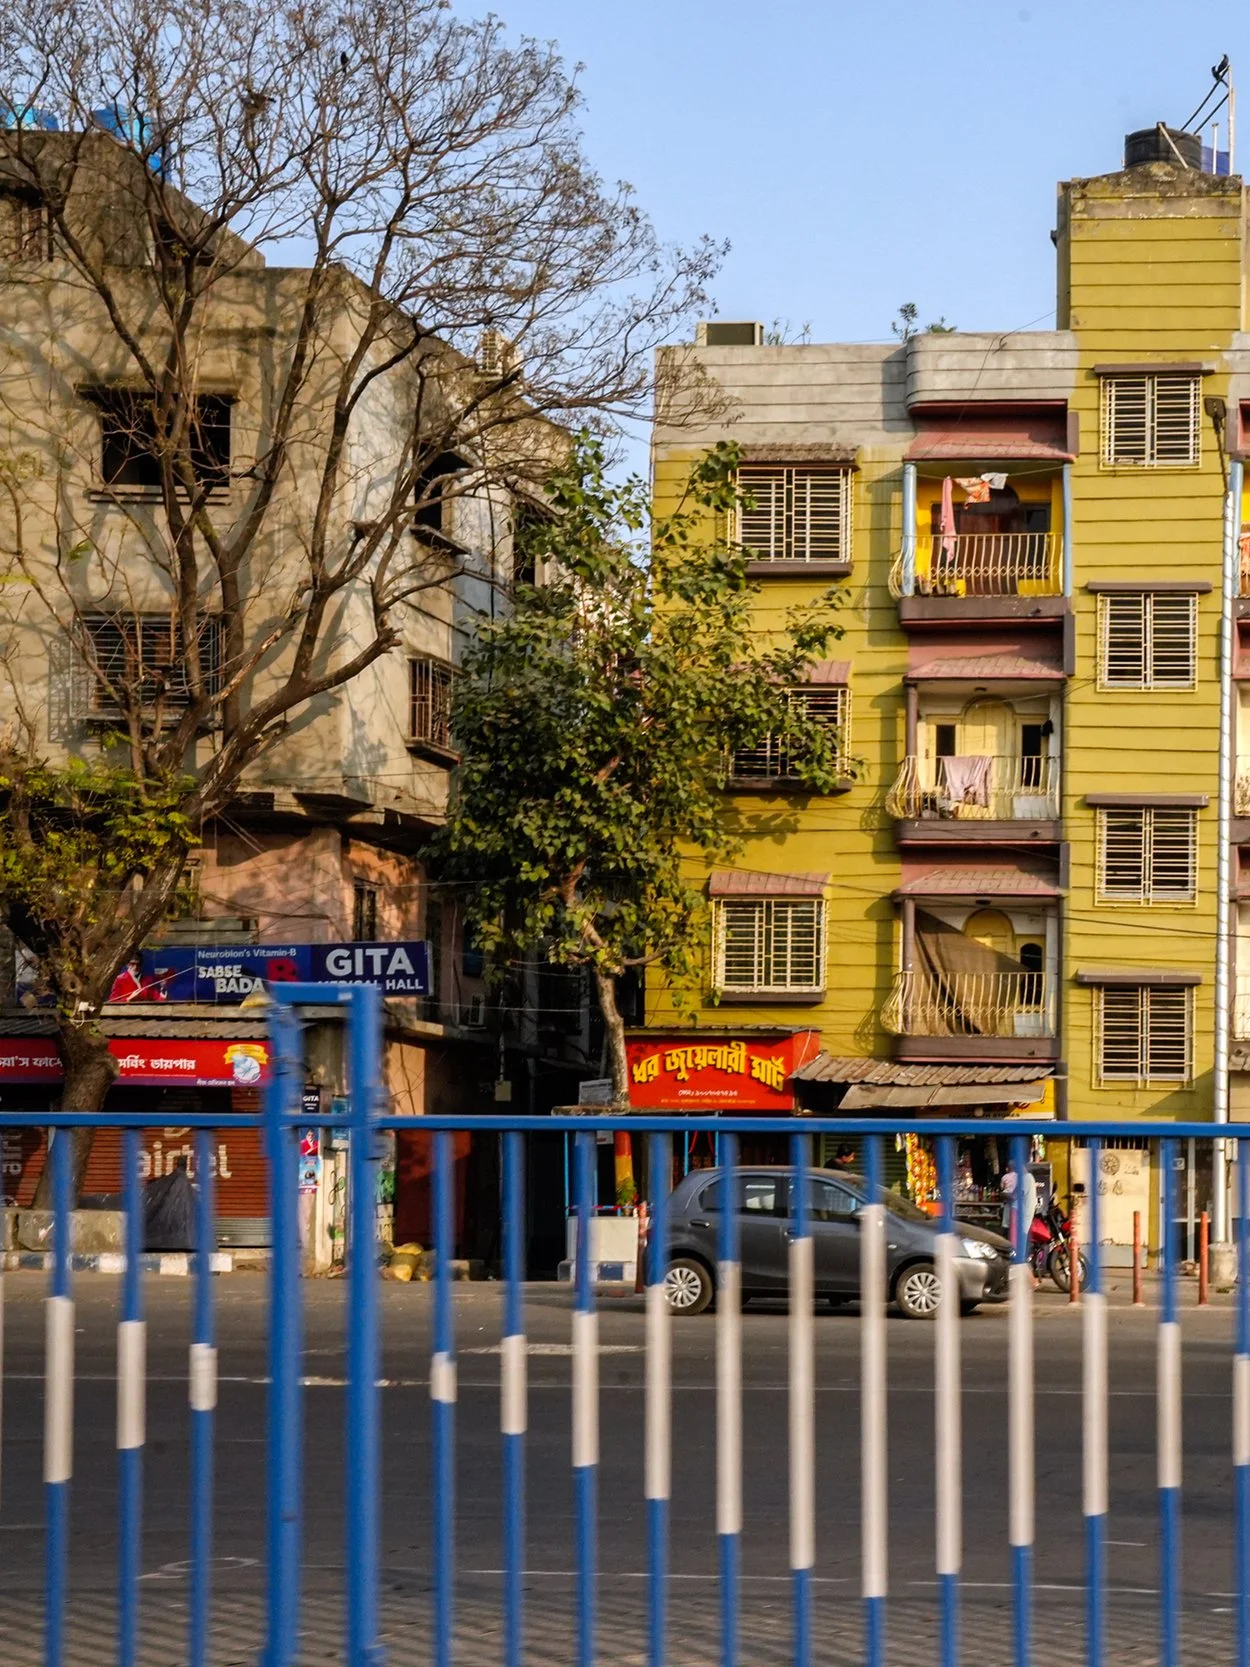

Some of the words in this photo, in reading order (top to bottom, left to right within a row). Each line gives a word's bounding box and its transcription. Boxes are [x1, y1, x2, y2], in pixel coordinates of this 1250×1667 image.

[198, 949, 251, 958] Neurobion's
[253, 948, 297, 957] Vitamin-B
[325, 948, 415, 977] GITA
[198, 965, 242, 979] SABSE
[215, 977, 266, 994] BADA
[385, 978, 424, 991] HALL
